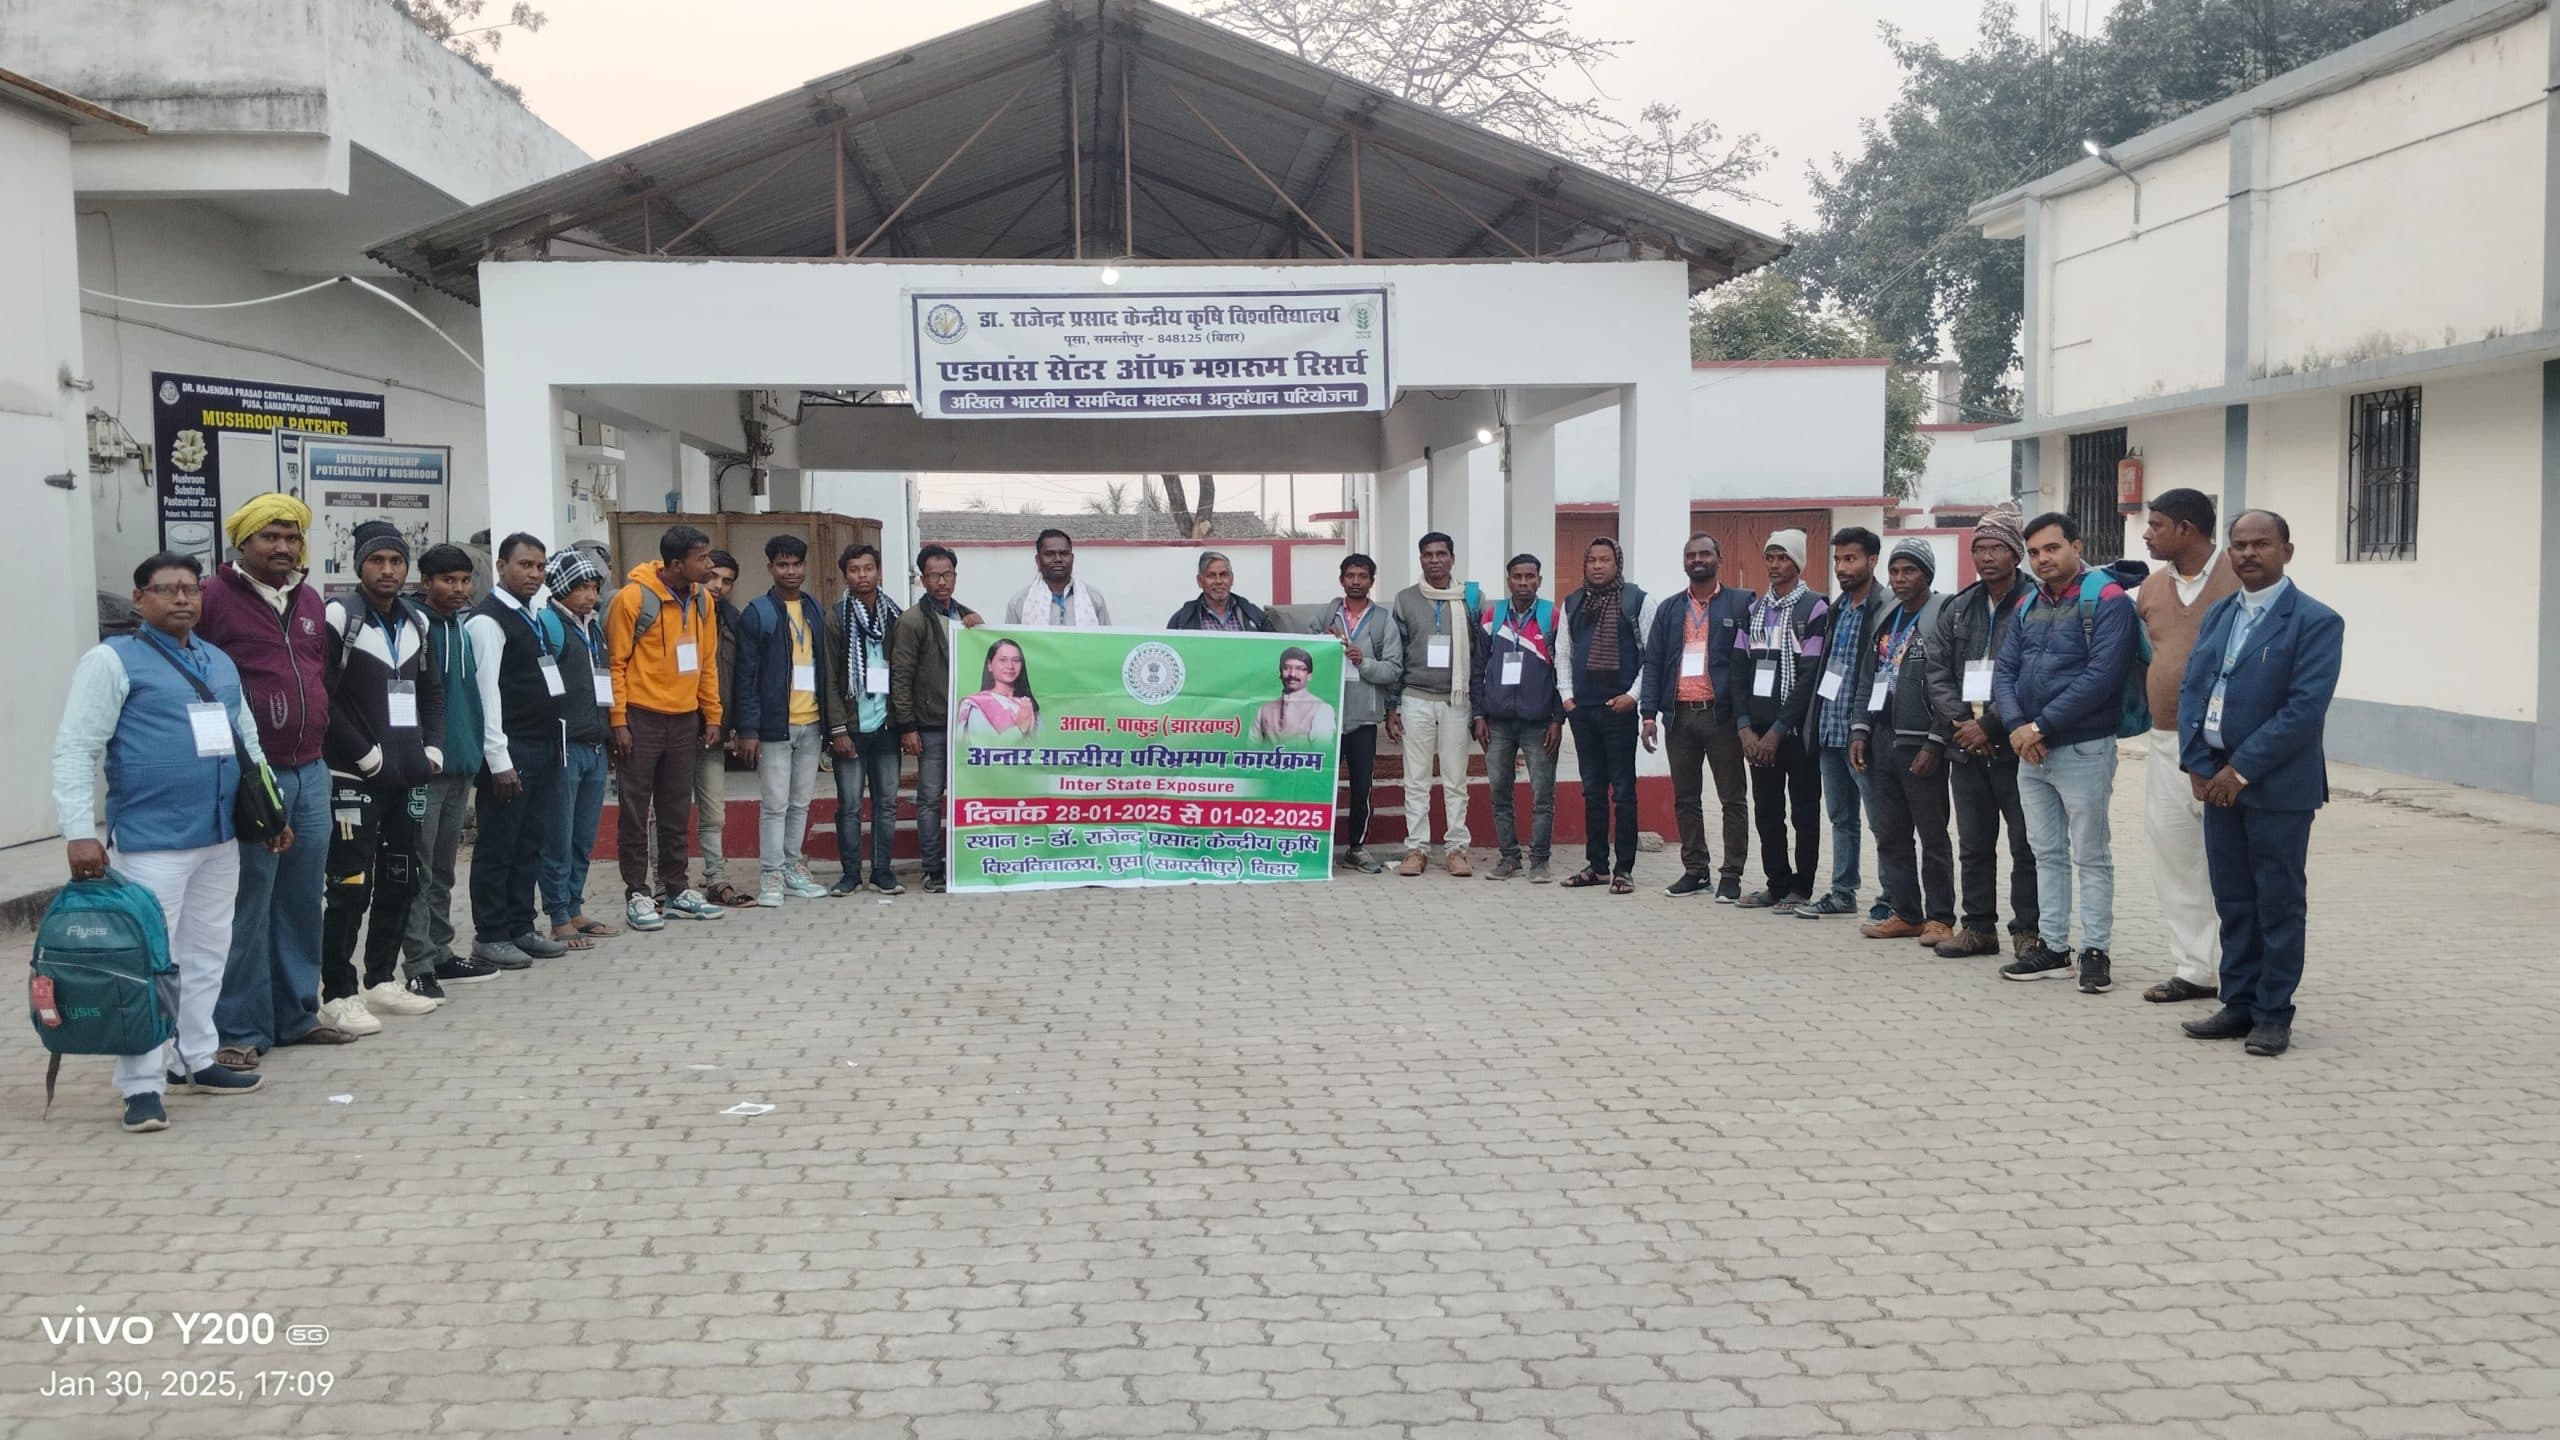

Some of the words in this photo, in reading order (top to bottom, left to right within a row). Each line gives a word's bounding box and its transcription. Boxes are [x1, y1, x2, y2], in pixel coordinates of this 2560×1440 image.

[977, 311, 1004, 328] डा.
[1010, 306, 1065, 328] राजेन्द्र
[1069, 310, 1119, 328] प्रसाद
[1122, 305, 1183, 328] केन्द्रीय
[1185, 305, 1225, 331] कृषि
[1228, 304, 1341, 325] विश्वविद्यालय
[1093, 331, 1144, 347] समस्तीपुर
[1157, 334, 1202, 343] 848125
[1206, 330, 1246, 344] (बिहार)
[936, 354, 1039, 382] एडवांस
[1045, 354, 1107, 381] सेंटर
[1116, 353, 1185, 380] ऑफ
[1294, 349, 1368, 377] रिसर्च
[182, 382, 195, 393] DR.
[196, 384, 234, 396] RAJENDRA
[235, 388, 262, 399] PRASAD
[263, 390, 294, 402] CENTRAL
[295, 392, 343, 406] AGRICULTURAL
[344, 397, 380, 410] UNIVERSITY
[241, 399, 263, 411] PUSA,
[263, 401, 306, 413] SAMASTIPUR
[307, 404, 331, 417] (BIHAR)
[950, 393, 1004, 409] अखिल
[1010, 391, 1070, 410] भारतीय
[1207, 389, 1279, 409] अनुसंधान
[1282, 386, 1358, 406] परियोजना
[202, 409, 284, 429] MUSHROOM
[288, 416, 349, 436] PATENTS
[171, 473, 205, 485] Mushroom
[315, 465, 376, 478] POTENTIALITY
[377, 467, 389, 478] OF
[389, 467, 438, 479] MUSHROOM
[163, 496, 200, 507] Pasteurizer
[200, 497, 217, 508] 2023
[174, 485, 205, 496] Substrate
[1060, 716, 1111, 735] आत्मा,
[1162, 714, 1241, 738] (झारखण्ड)
[967, 747, 1034, 767] अन्तर
[1039, 744, 1125, 767] राज्यीय
[1130, 745, 1229, 769] परिभ्रमण
[1233, 745, 1325, 771] कार्यक्रम
[1060, 777, 1102, 791] Inter
[1106, 777, 1152, 791] State
[1156, 778, 1235, 794] Exposure
[964, 801, 1050, 823] दिनांक
[1055, 804, 1172, 822] 28-01-2025
[1178, 804, 1204, 825] से
[1209, 807, 1323, 828] 01-02-2025
[965, 833, 1018, 849] स्थान
[1050, 828, 1078, 847] डॉ.
[1085, 828, 1143, 846] राजेन्द्र
[1148, 831, 1200, 848] प्रसाद
[1206, 831, 1273, 851] केन्द्रीय
[1278, 834, 1319, 856] कृषि
[1145, 853, 1244, 878] (समस्तीपुर)
[1251, 859, 1298, 876] बिहार
[67, 925, 108, 938] Flysis
[63, 1003, 102, 1019] lysis
